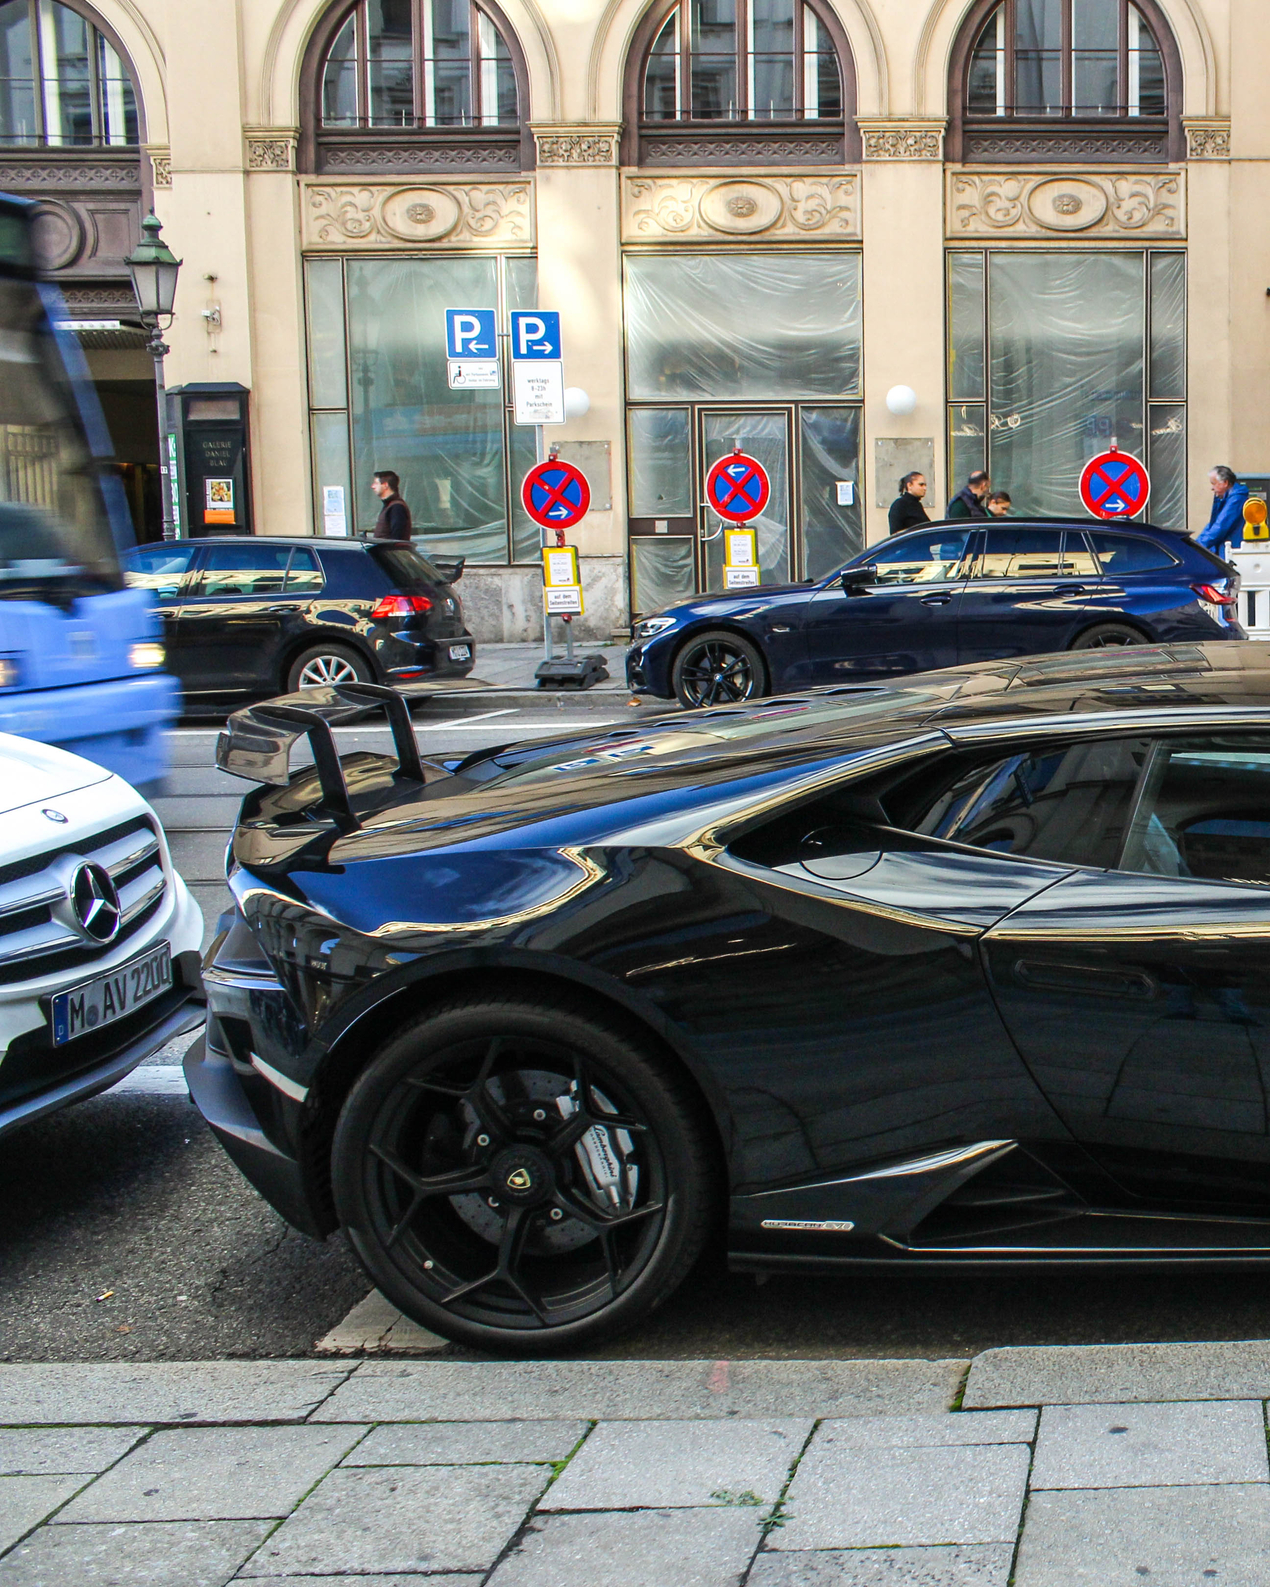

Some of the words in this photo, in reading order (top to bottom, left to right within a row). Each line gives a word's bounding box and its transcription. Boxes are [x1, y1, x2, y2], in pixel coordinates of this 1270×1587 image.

[454, 315, 481, 353] P
[519, 317, 546, 355] P
[202, 441, 232, 449] GALERIE
[205, 450, 231, 458] DANIEL
[69, 992, 86, 1033] M
[102, 973, 129, 1020] AV
[593, 1125, 618, 1178] Lamborghini
